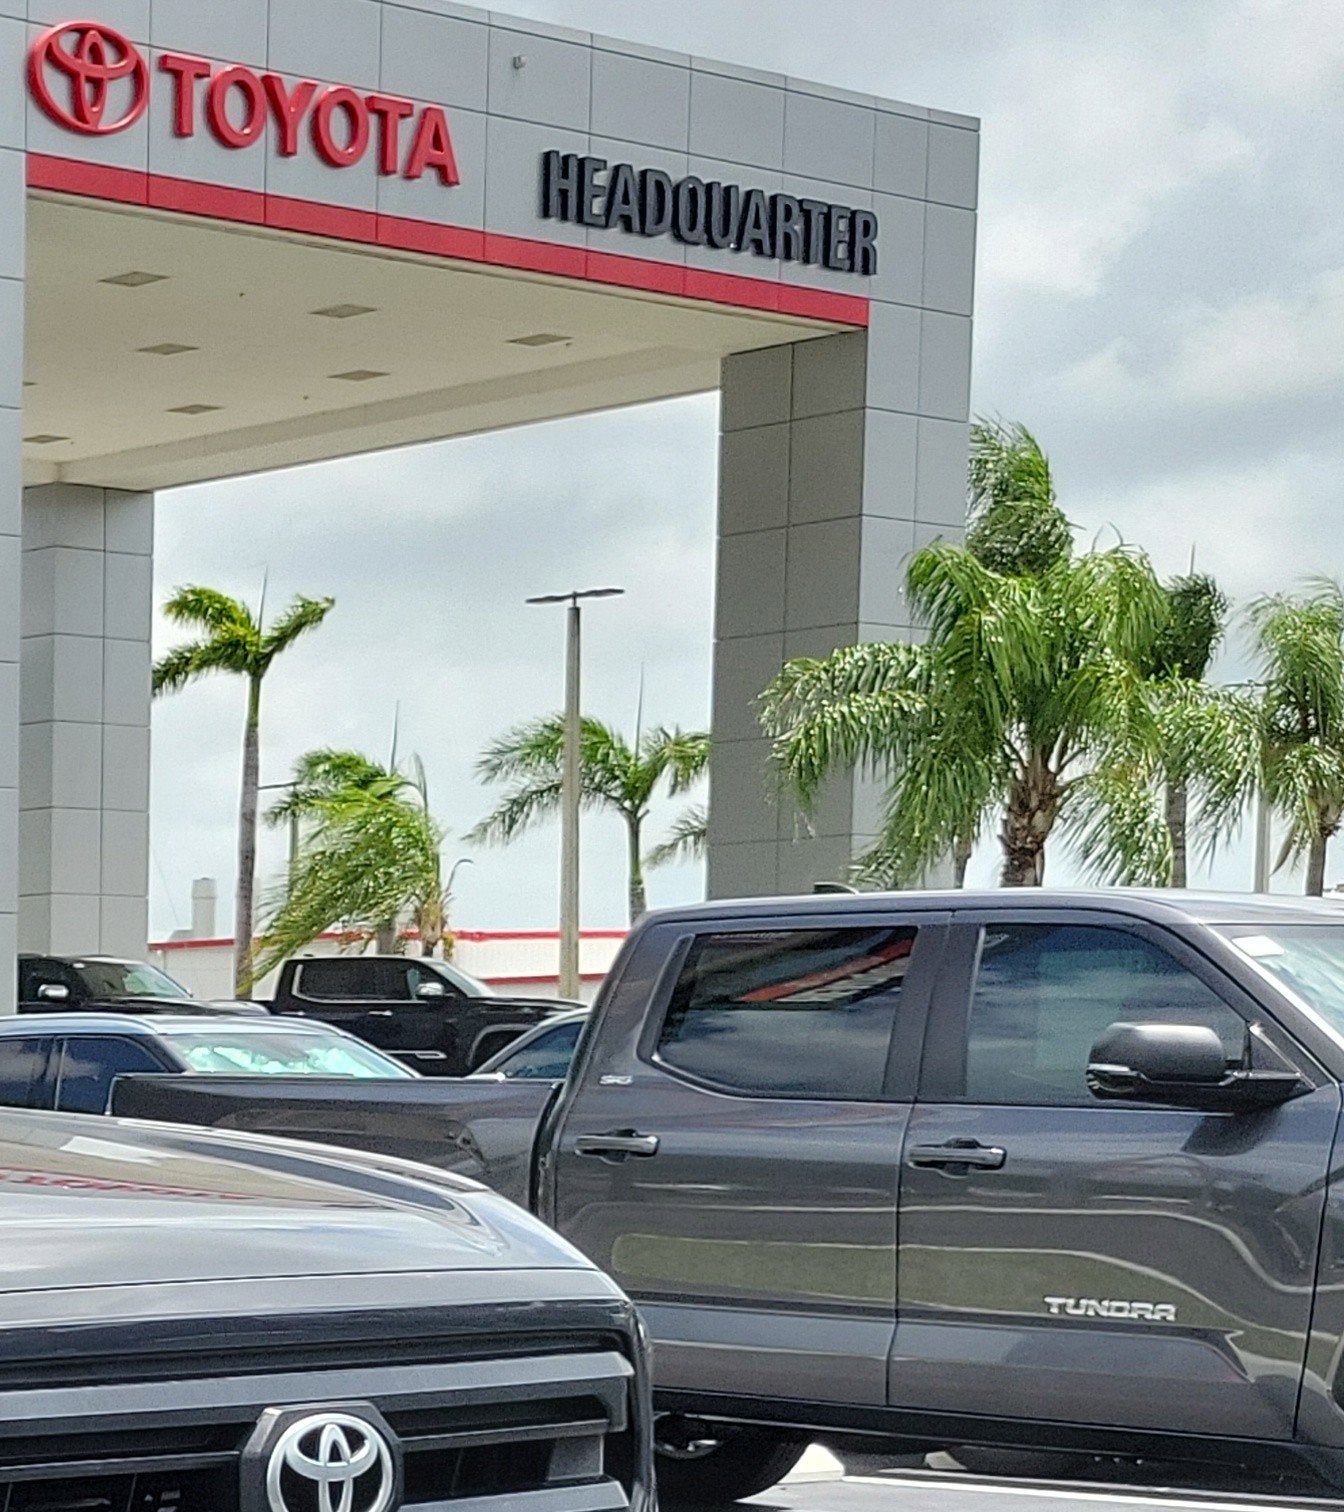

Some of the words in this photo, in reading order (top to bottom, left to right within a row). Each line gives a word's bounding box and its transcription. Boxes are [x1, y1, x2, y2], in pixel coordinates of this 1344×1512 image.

[159, 53, 460, 187] TOYOTA
[541, 150, 879, 276] HEADQUARTER
[1044, 1296, 1177, 1321] TUNDRA
